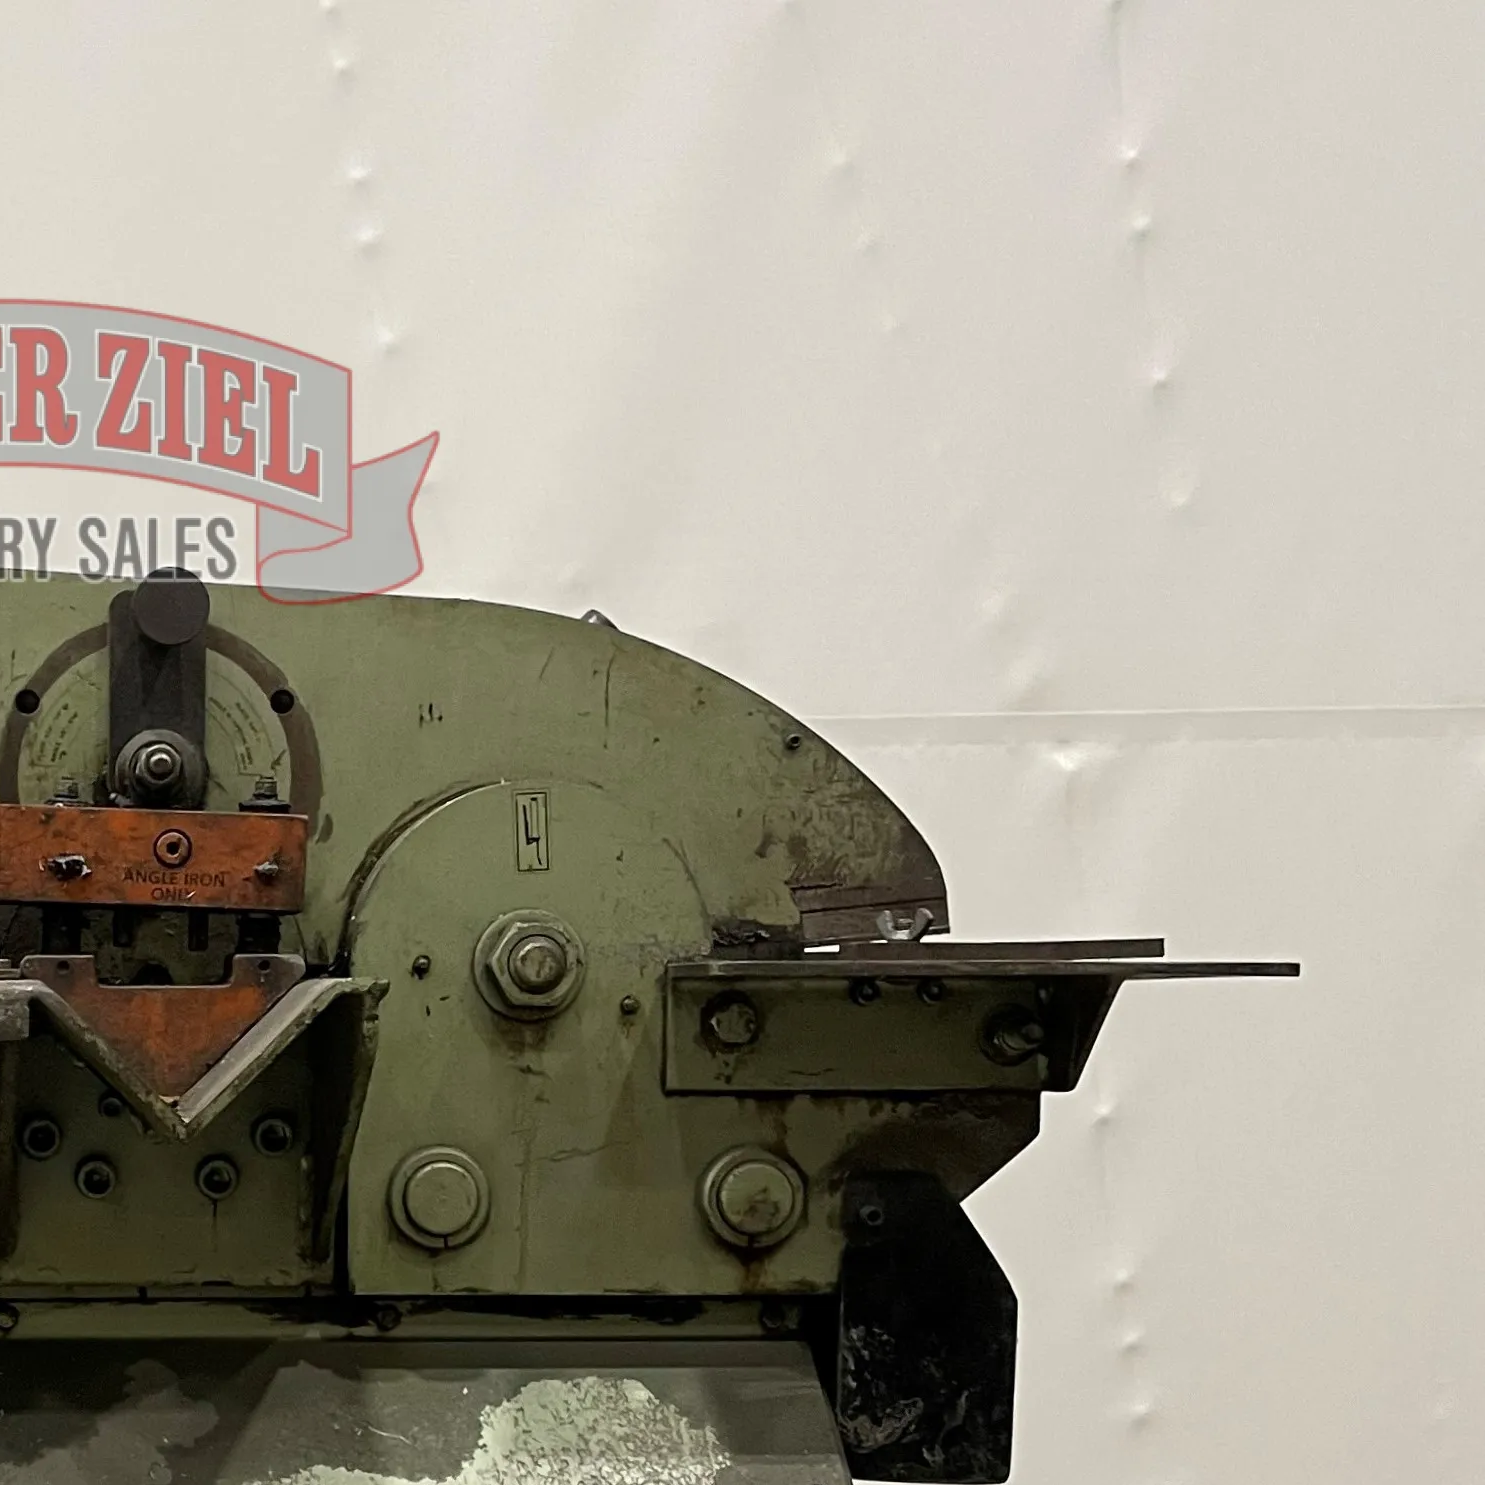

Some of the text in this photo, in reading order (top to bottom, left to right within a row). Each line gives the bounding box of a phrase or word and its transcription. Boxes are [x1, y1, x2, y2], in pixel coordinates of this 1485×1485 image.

[122, 868, 225, 887] ANGLE IRON
[151, 888, 196, 901] ONLY
